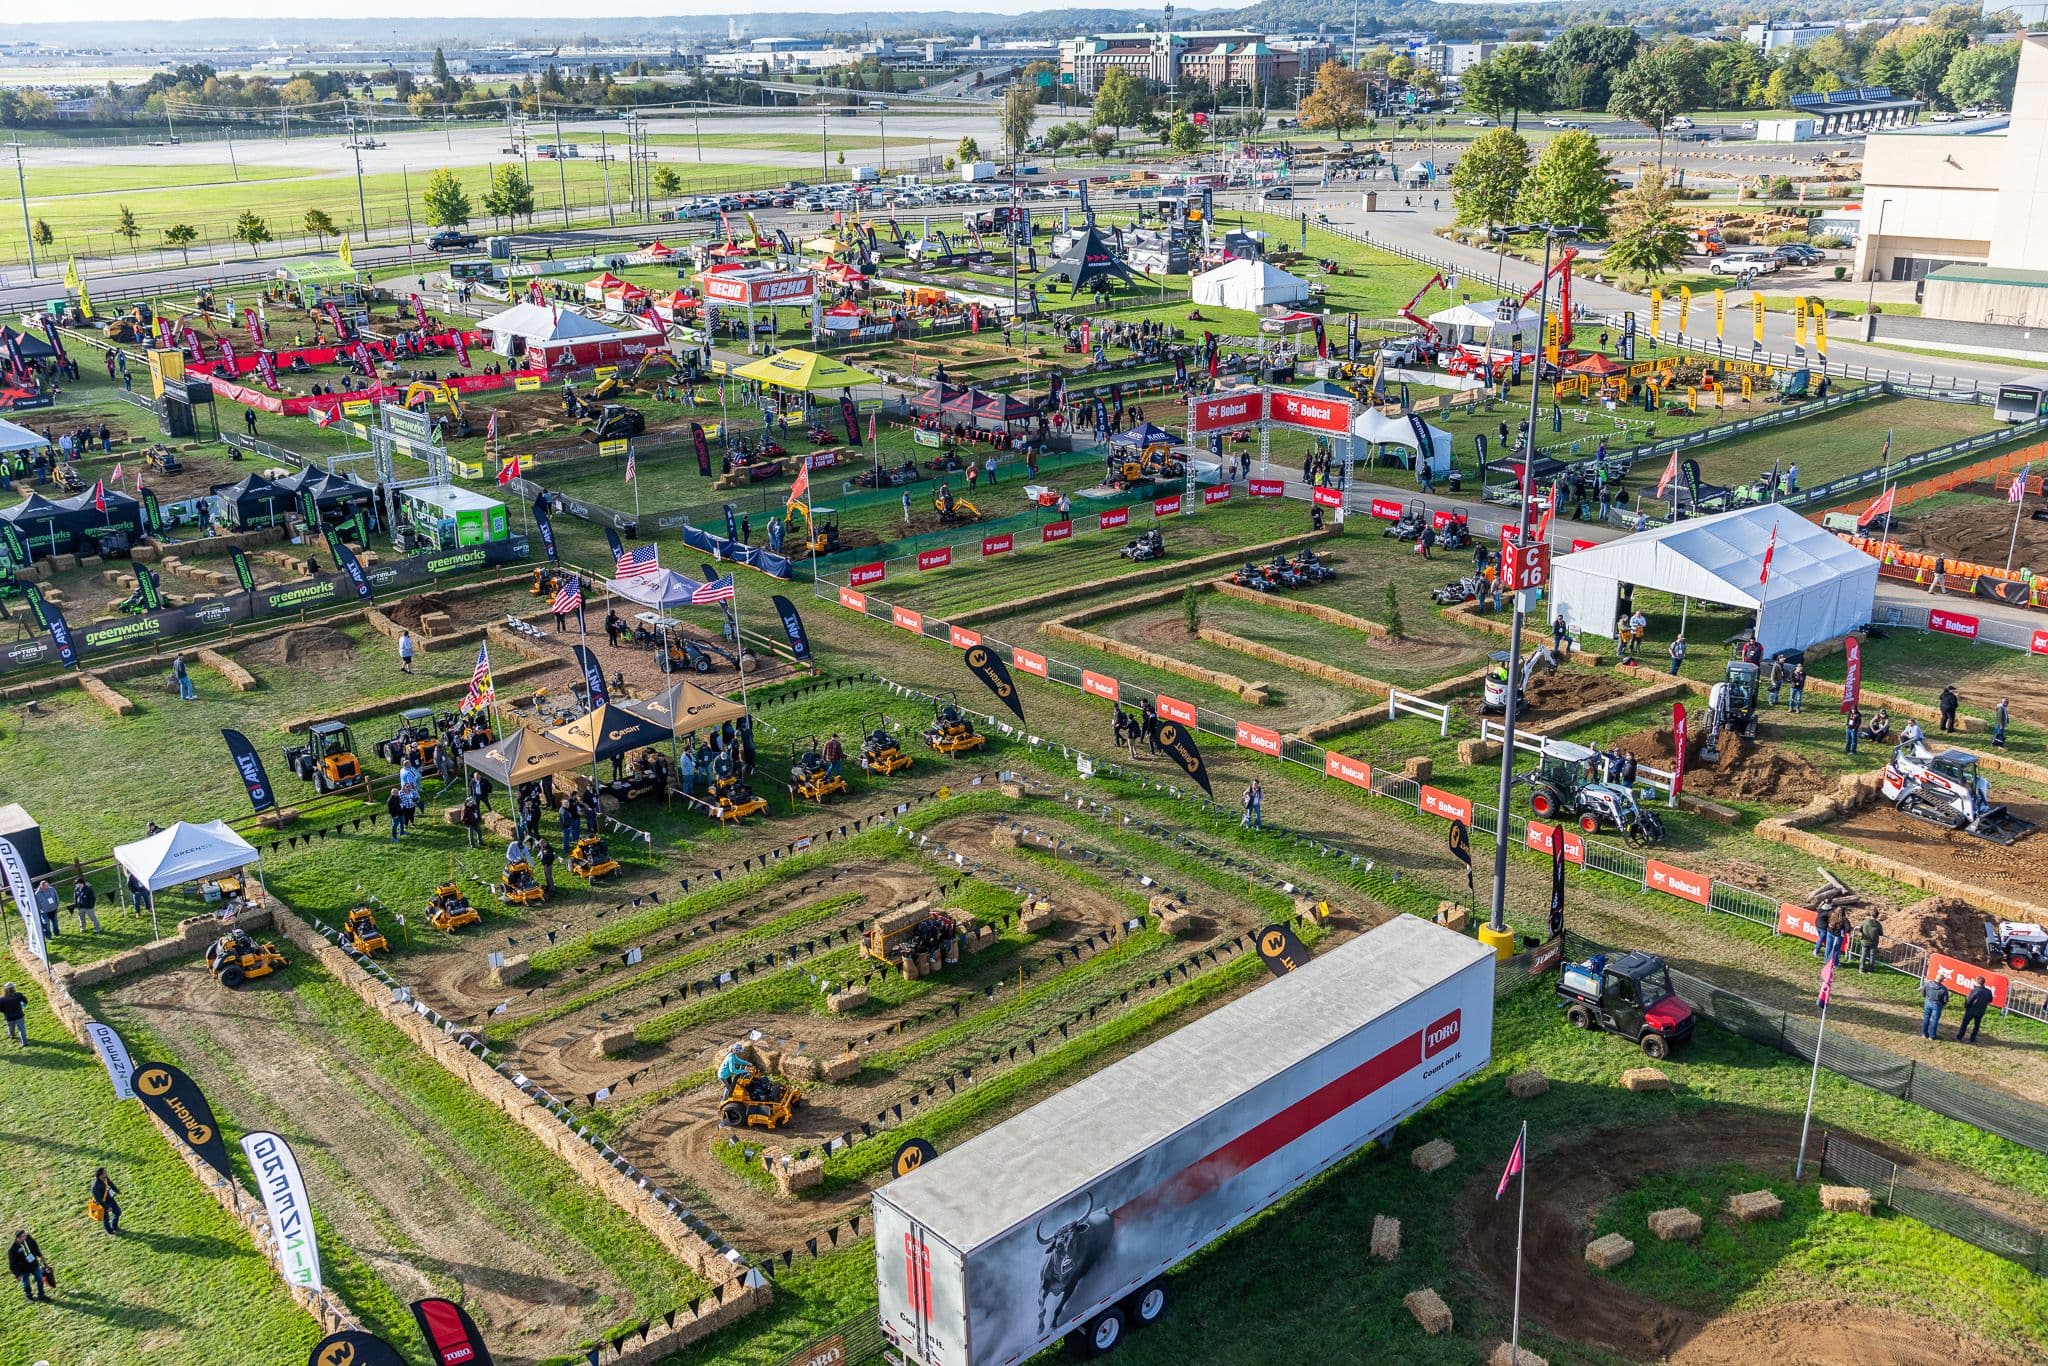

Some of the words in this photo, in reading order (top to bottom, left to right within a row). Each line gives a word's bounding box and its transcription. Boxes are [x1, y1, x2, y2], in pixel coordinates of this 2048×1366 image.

[718, 282, 742, 299] ECHO
[770, 279, 807, 297] ECHO
[860, 324, 893, 336] ECHO
[1096, 402, 1106, 431] KATO
[1220, 402, 1247, 418] Bobcat
[1300, 404, 1331, 420] Bobcat
[1147, 432, 1167, 441] KATO
[1214, 490, 1230, 500] Bobcat
[1261, 485, 1283, 495] Bobcat
[1323, 493, 1340, 504] Bobcat
[1162, 501, 1179, 512] Bobcat
[1382, 506, 1401, 518] Bobcat
[85, 520, 134, 535] greenworks
[1109, 514, 1126, 525] Bobcat
[539, 522, 554, 556] GIANT
[1053, 526, 1069, 537] Bobcat
[993, 540, 1010, 550] Bobcat
[427, 549, 487, 572] greenworks
[931, 554, 947, 565] Bobcat
[1506, 545, 1513, 564] C
[1526, 547, 1540, 567] C
[348, 561, 367, 597] GIANT
[862, 568, 882, 581] Bobcat
[1503, 563, 1514, 586] 16
[1520, 566, 1542, 588] 16
[269, 581, 335, 608] greenworks
[849, 595, 863, 608] Bobcat
[195, 606, 231, 619] OPTIMUS
[903, 616, 918, 628] Bobcat
[1945, 619, 1976, 635] Bobcat
[50, 620, 72, 659] GIANT
[86, 617, 160, 646] greenworks
[784, 615, 804, 653] GIANT
[8, 643, 48, 658] OPTIMUS
[1025, 658, 1042, 671] Bobcat
[588, 669, 605, 707] GIANT
[984, 666, 1011, 697] WRIGHT
[1095, 682, 1113, 695] Bobcat
[687, 700, 717, 716] WRIGHT
[1170, 706, 1192, 723] Bobcat
[608, 724, 641, 741] WRIGHT
[1251, 733, 1278, 751] Bobcat
[527, 750, 560, 765] WRIGHT
[1174, 742, 1200, 772] WRIGHT
[238, 754, 265, 800] GIANT
[1341, 764, 1365, 782] Bobcat
[1438, 799, 1465, 818] Bobcat
[1545, 835, 1579, 857] Bcat
[1668, 876, 1701, 897] Bobcat
[1426, 1019, 1460, 1049] TORO
[1422, 1061, 1445, 1080] Count
[1444, 1056, 1455, 1068] on
[1454, 1052, 1463, 1064] it.
[165, 1096, 212, 1145] WRIGHT
[326, 1341, 351, 1366] W
[443, 1347, 472, 1361] TORO
